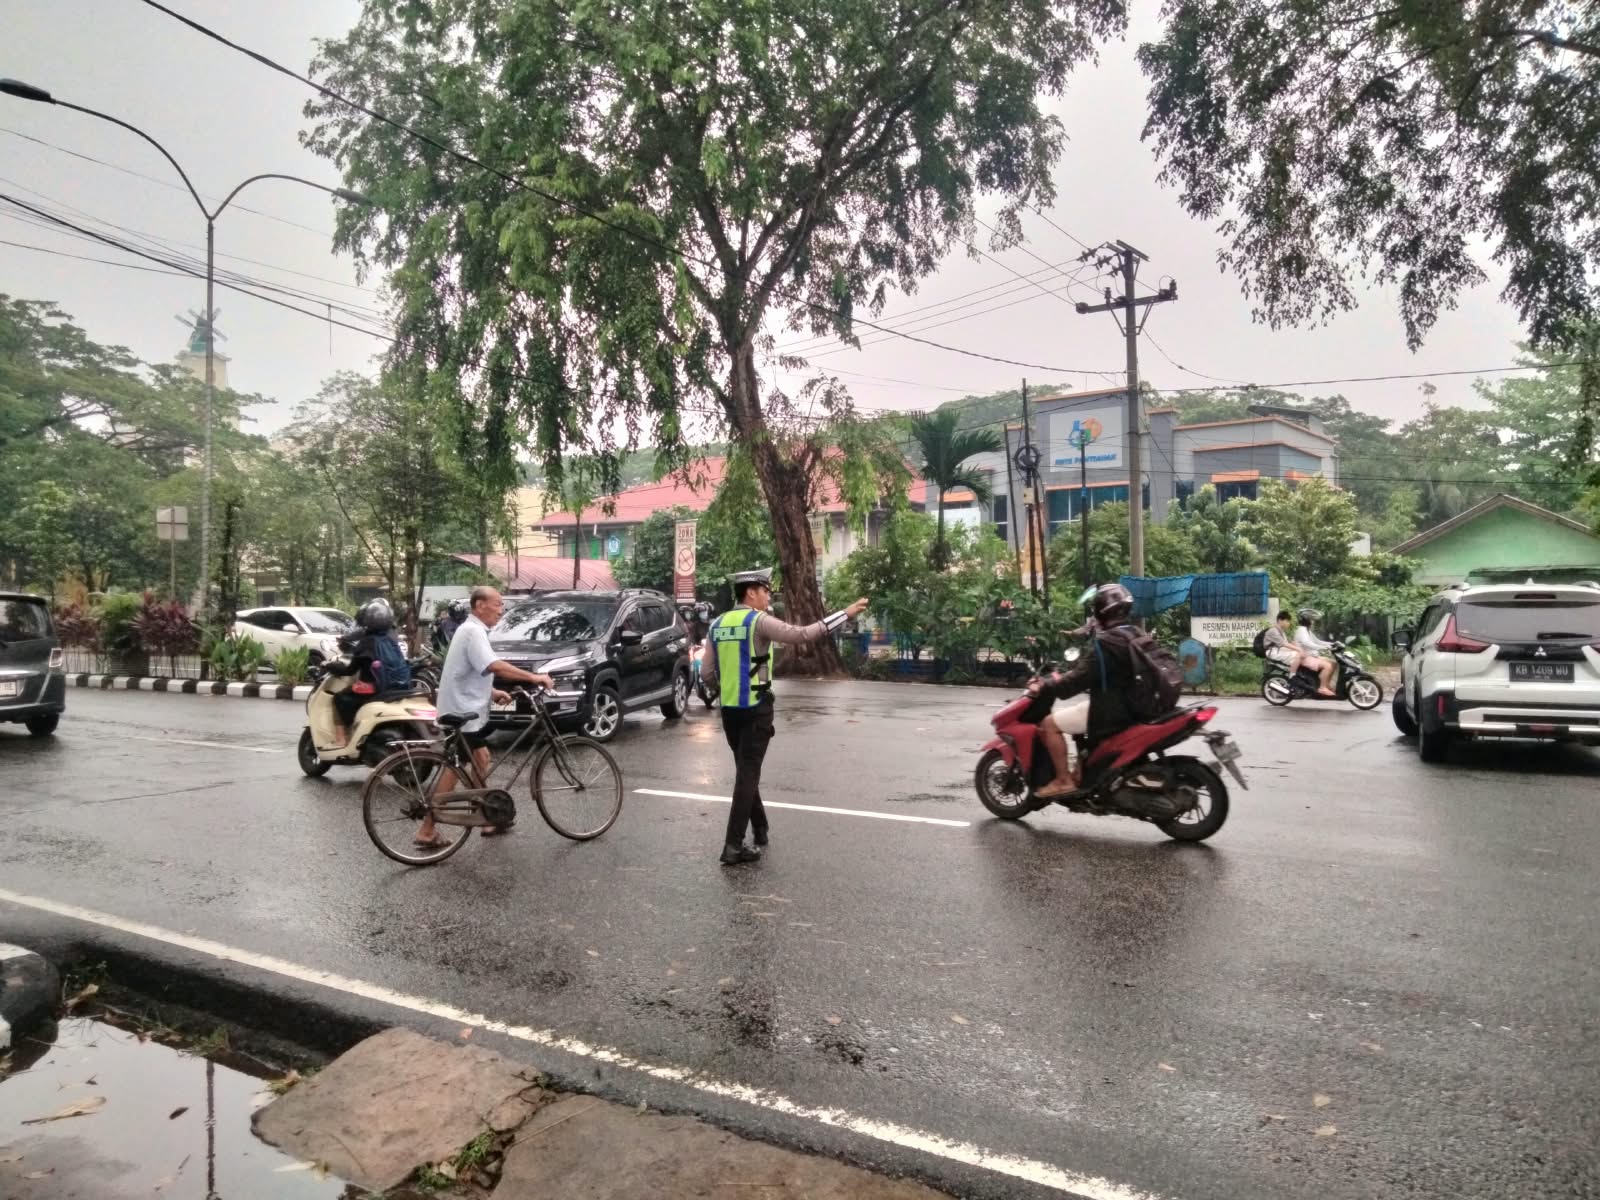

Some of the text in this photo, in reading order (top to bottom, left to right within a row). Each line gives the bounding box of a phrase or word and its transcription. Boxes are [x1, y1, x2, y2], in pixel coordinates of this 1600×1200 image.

[1202, 621, 1264, 632] RESIMEN MAHAPUR
[1208, 632, 1243, 640] KALIMANTAN
[1515, 664, 1528, 675] KB
